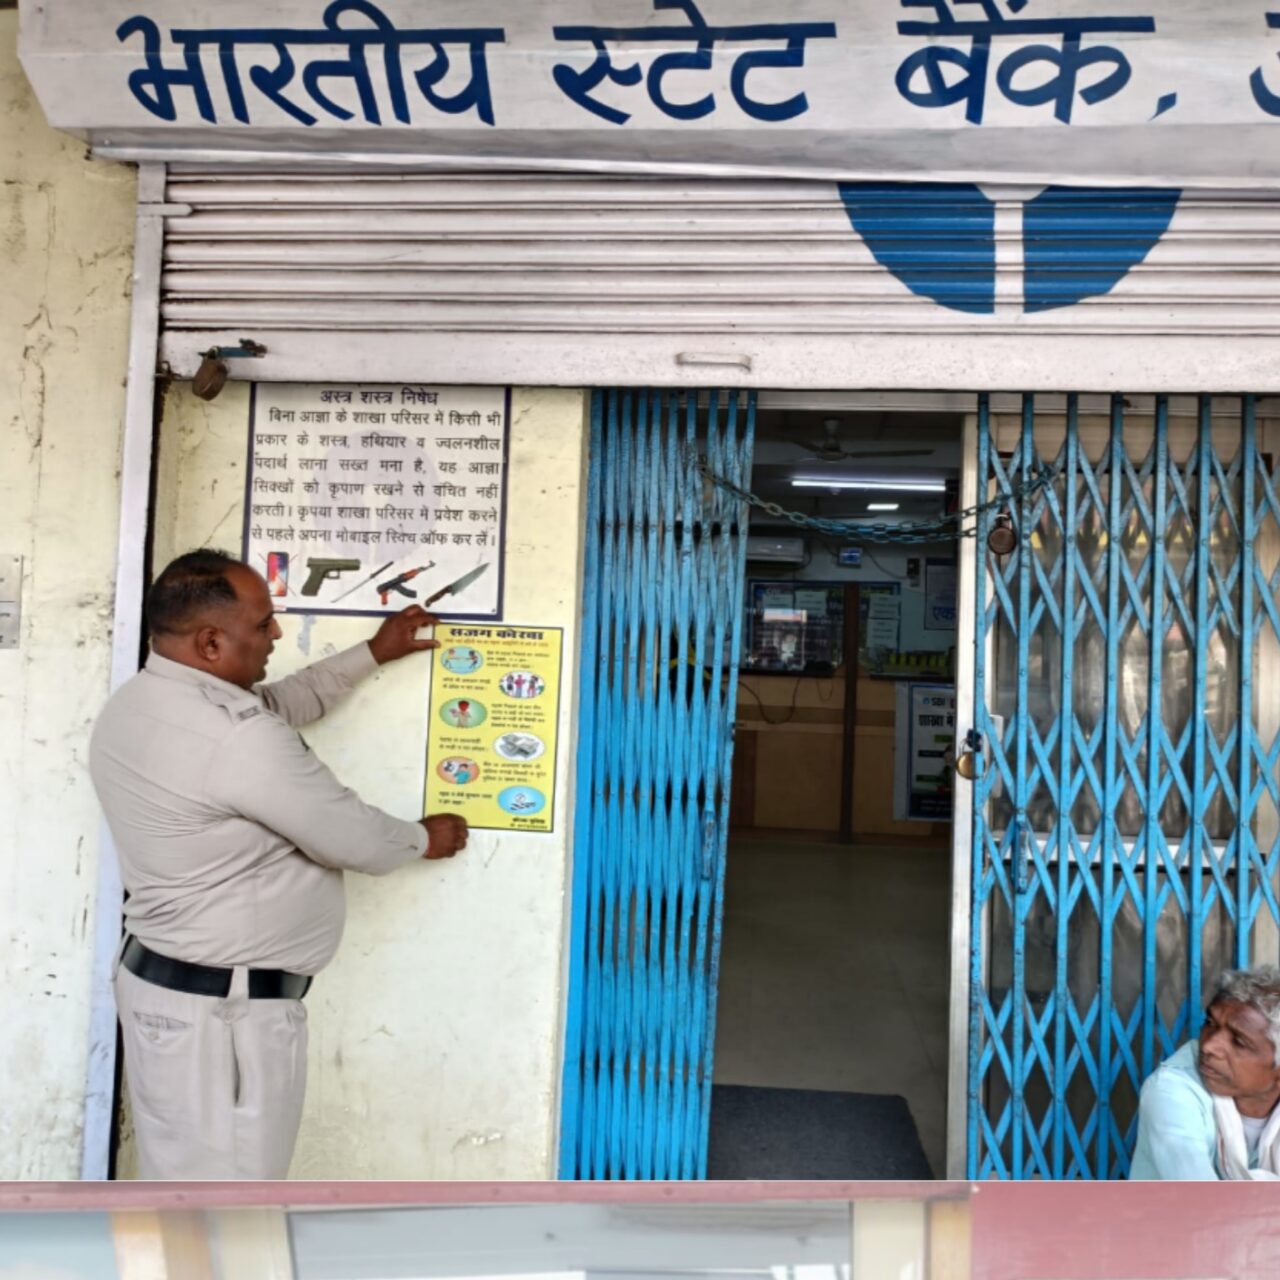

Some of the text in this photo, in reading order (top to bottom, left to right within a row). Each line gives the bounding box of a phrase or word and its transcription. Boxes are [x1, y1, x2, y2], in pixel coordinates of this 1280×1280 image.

[116, 0, 505, 125] भारतीय
[553, 0, 836, 125] स्टेट
[320, 387, 439, 405] अस्त्र शस्त्र निषेध
[269, 407, 295, 422] बिना
[300, 410, 330, 423] आज्ञा
[335, 408, 347, 422] के
[352, 411, 386, 424] शाखा
[391, 408, 430, 424] परिसर
[449, 410, 481, 426] किसी
[486, 411, 501, 426] भी
[255, 433, 287, 446] प्रकार
[297, 429, 309, 446] के
[360, 431, 406, 448] हथियार
[416, 437, 425, 447] व
[436, 434, 501, 450] ज्वलनशील
[254, 455, 287, 469] पदार्थ
[298, 458, 328, 470] लाना
[339, 458, 369, 471] सख्त
[380, 459, 403, 472] मना
[438, 461, 457, 474] यह
[468, 461, 499, 475] आज्ञा
[303, 478, 319, 494] को
[328, 482, 365, 499] कृपाण
[373, 480, 403, 496] रखने
[412, 481, 424, 496] से
[476, 483, 499, 499] नहीं
[297, 505, 331, 521] कृपया
[337, 506, 370, 519] शाखा
[376, 504, 414, 520] परिसर
[434, 505, 463, 521] प्रवेश
[468, 506, 498, 522] करने
[251, 525, 262, 540] से
[266, 525, 294, 541] पहले
[298, 529, 331, 542] अपना
[336, 526, 381, 544] मोबाइल
[420, 530, 448, 545] ऑफ
[452, 533, 472, 545] कर
[450, 628, 544, 640] सजग कोरबा
